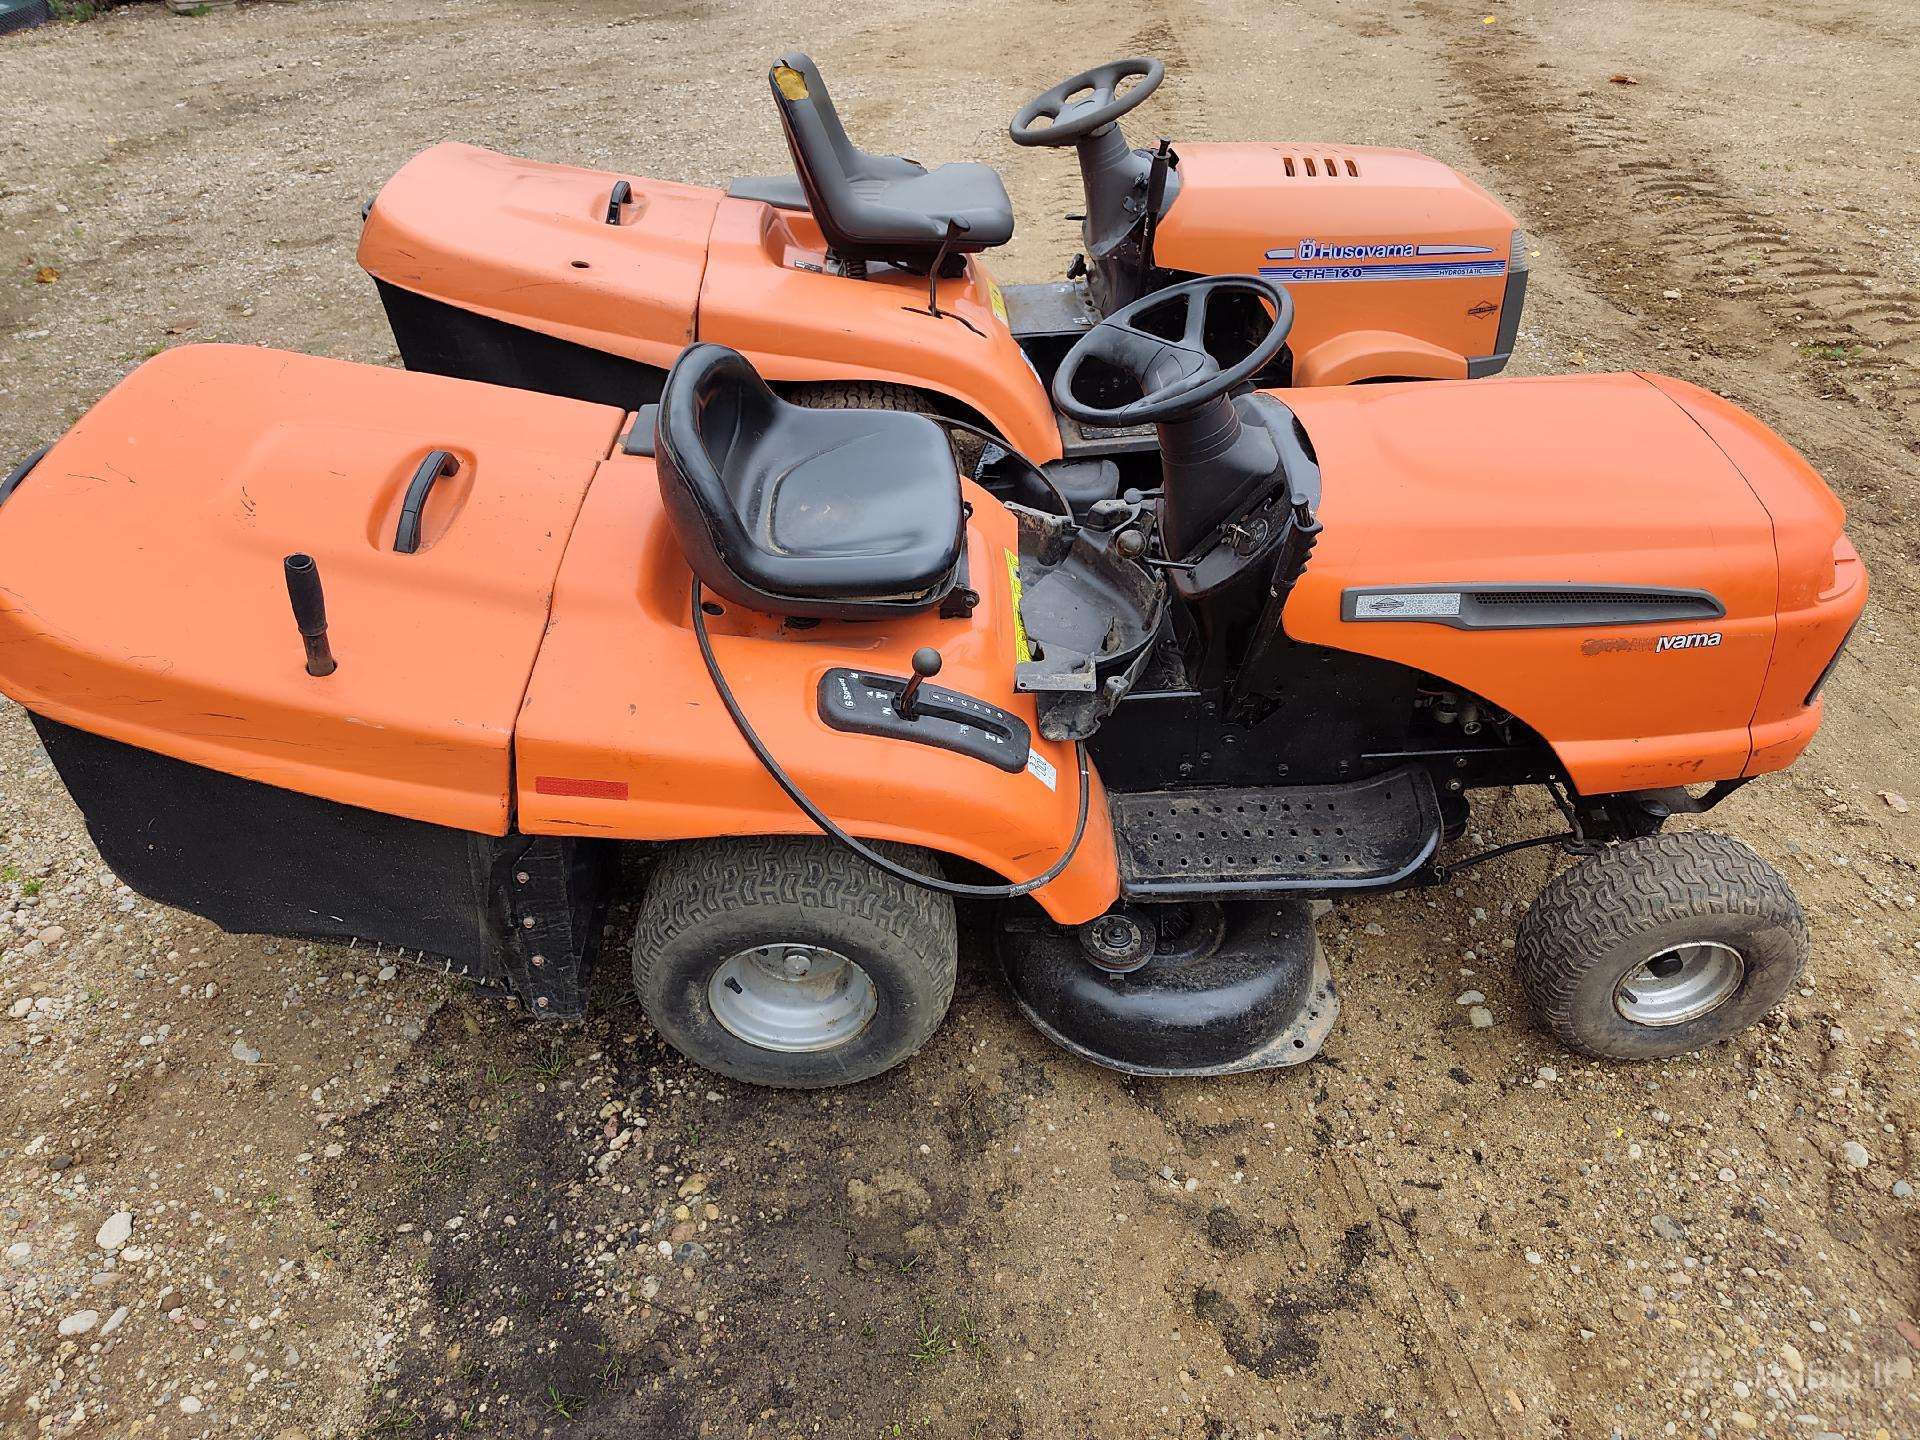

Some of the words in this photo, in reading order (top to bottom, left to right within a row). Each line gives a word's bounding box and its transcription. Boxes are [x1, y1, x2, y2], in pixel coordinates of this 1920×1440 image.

[1320, 243, 1414, 261] Husqvarna
[1292, 268, 1326, 279] CTH
[1334, 268, 1363, 278] 160
